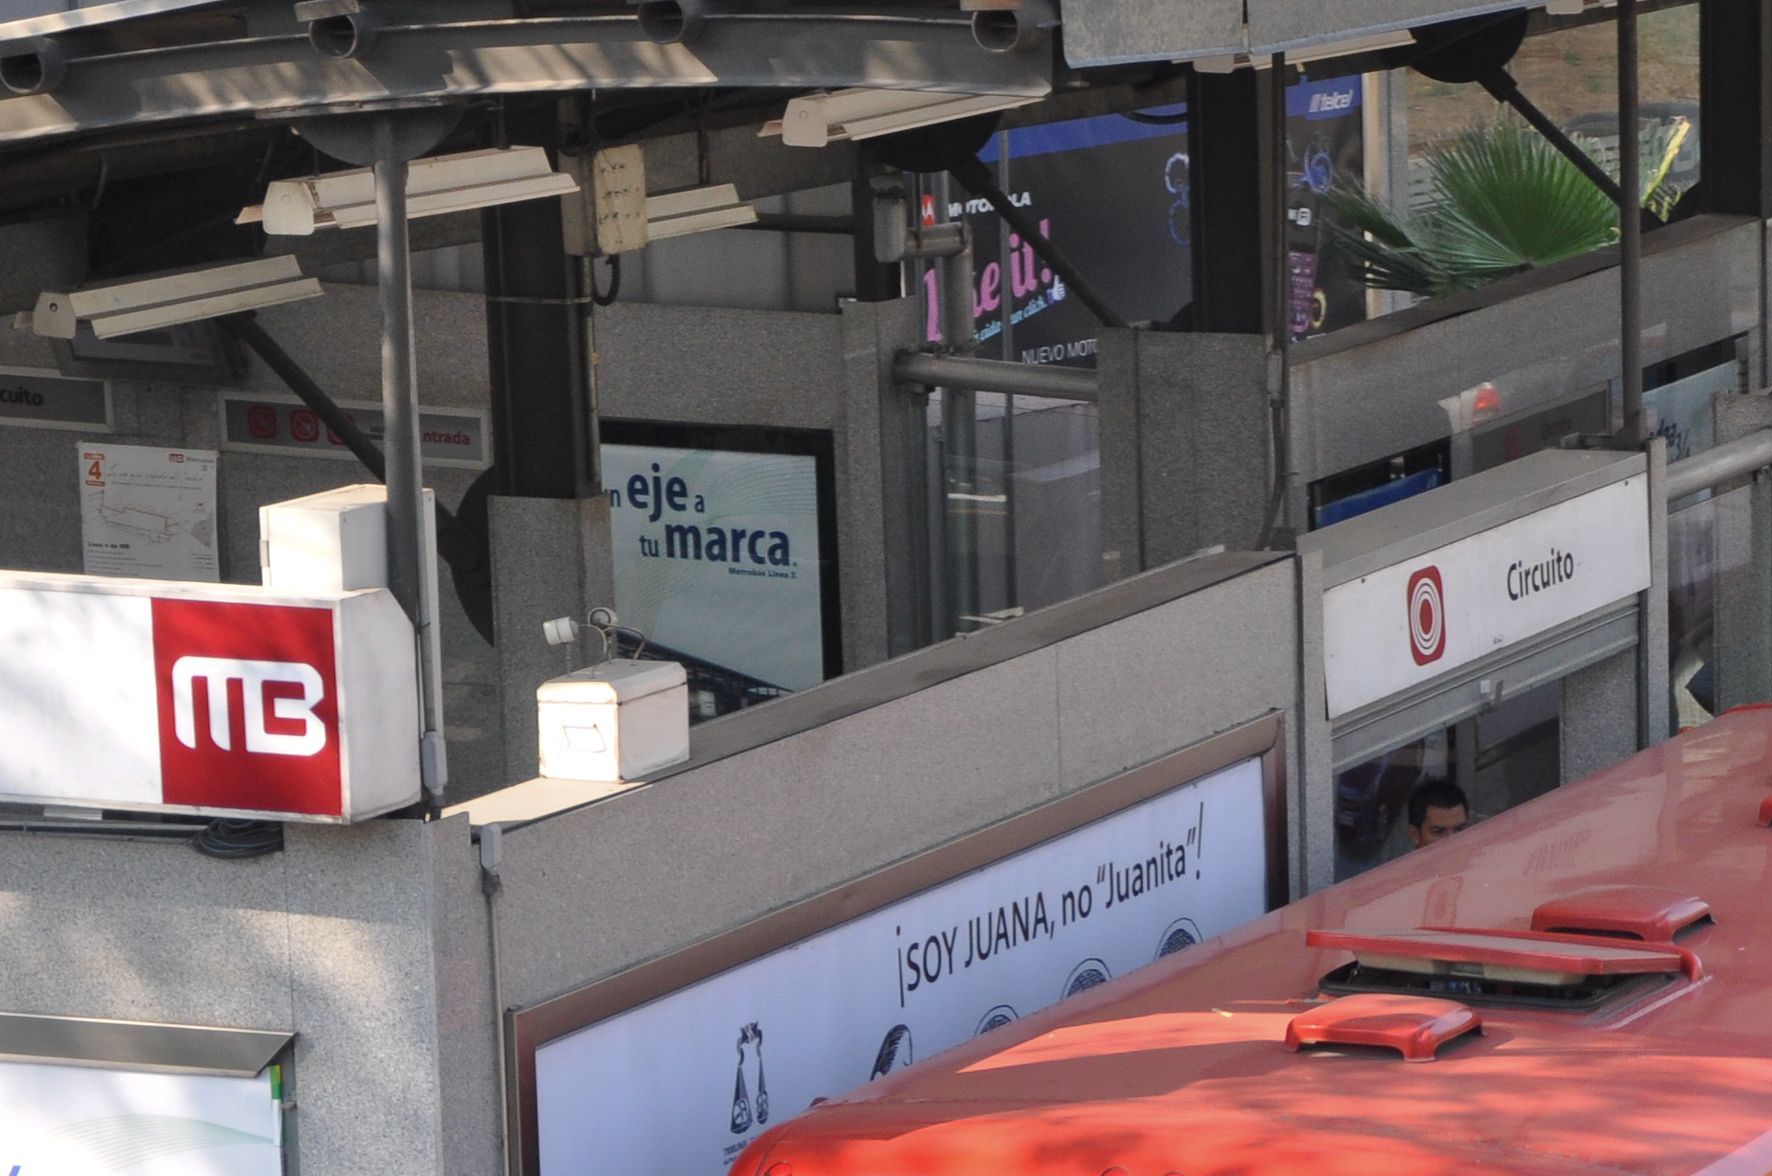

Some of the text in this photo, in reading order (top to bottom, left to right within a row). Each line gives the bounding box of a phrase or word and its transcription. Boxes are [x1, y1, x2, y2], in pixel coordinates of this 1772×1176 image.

[1022, 344, 1064, 365] NUEVO
[423, 430, 470, 445] ntrada
[88, 461, 102, 480] 4
[627, 463, 688, 522] eje
[694, 494, 705, 513] a
[639, 524, 797, 566] tu marca.
[1507, 548, 1574, 601] Circuito
[172, 655, 327, 756] MB
[896, 924, 958, 1009] ¡SOY
[964, 891, 1056, 968] JUANA,
[1062, 885, 1092, 927] no
